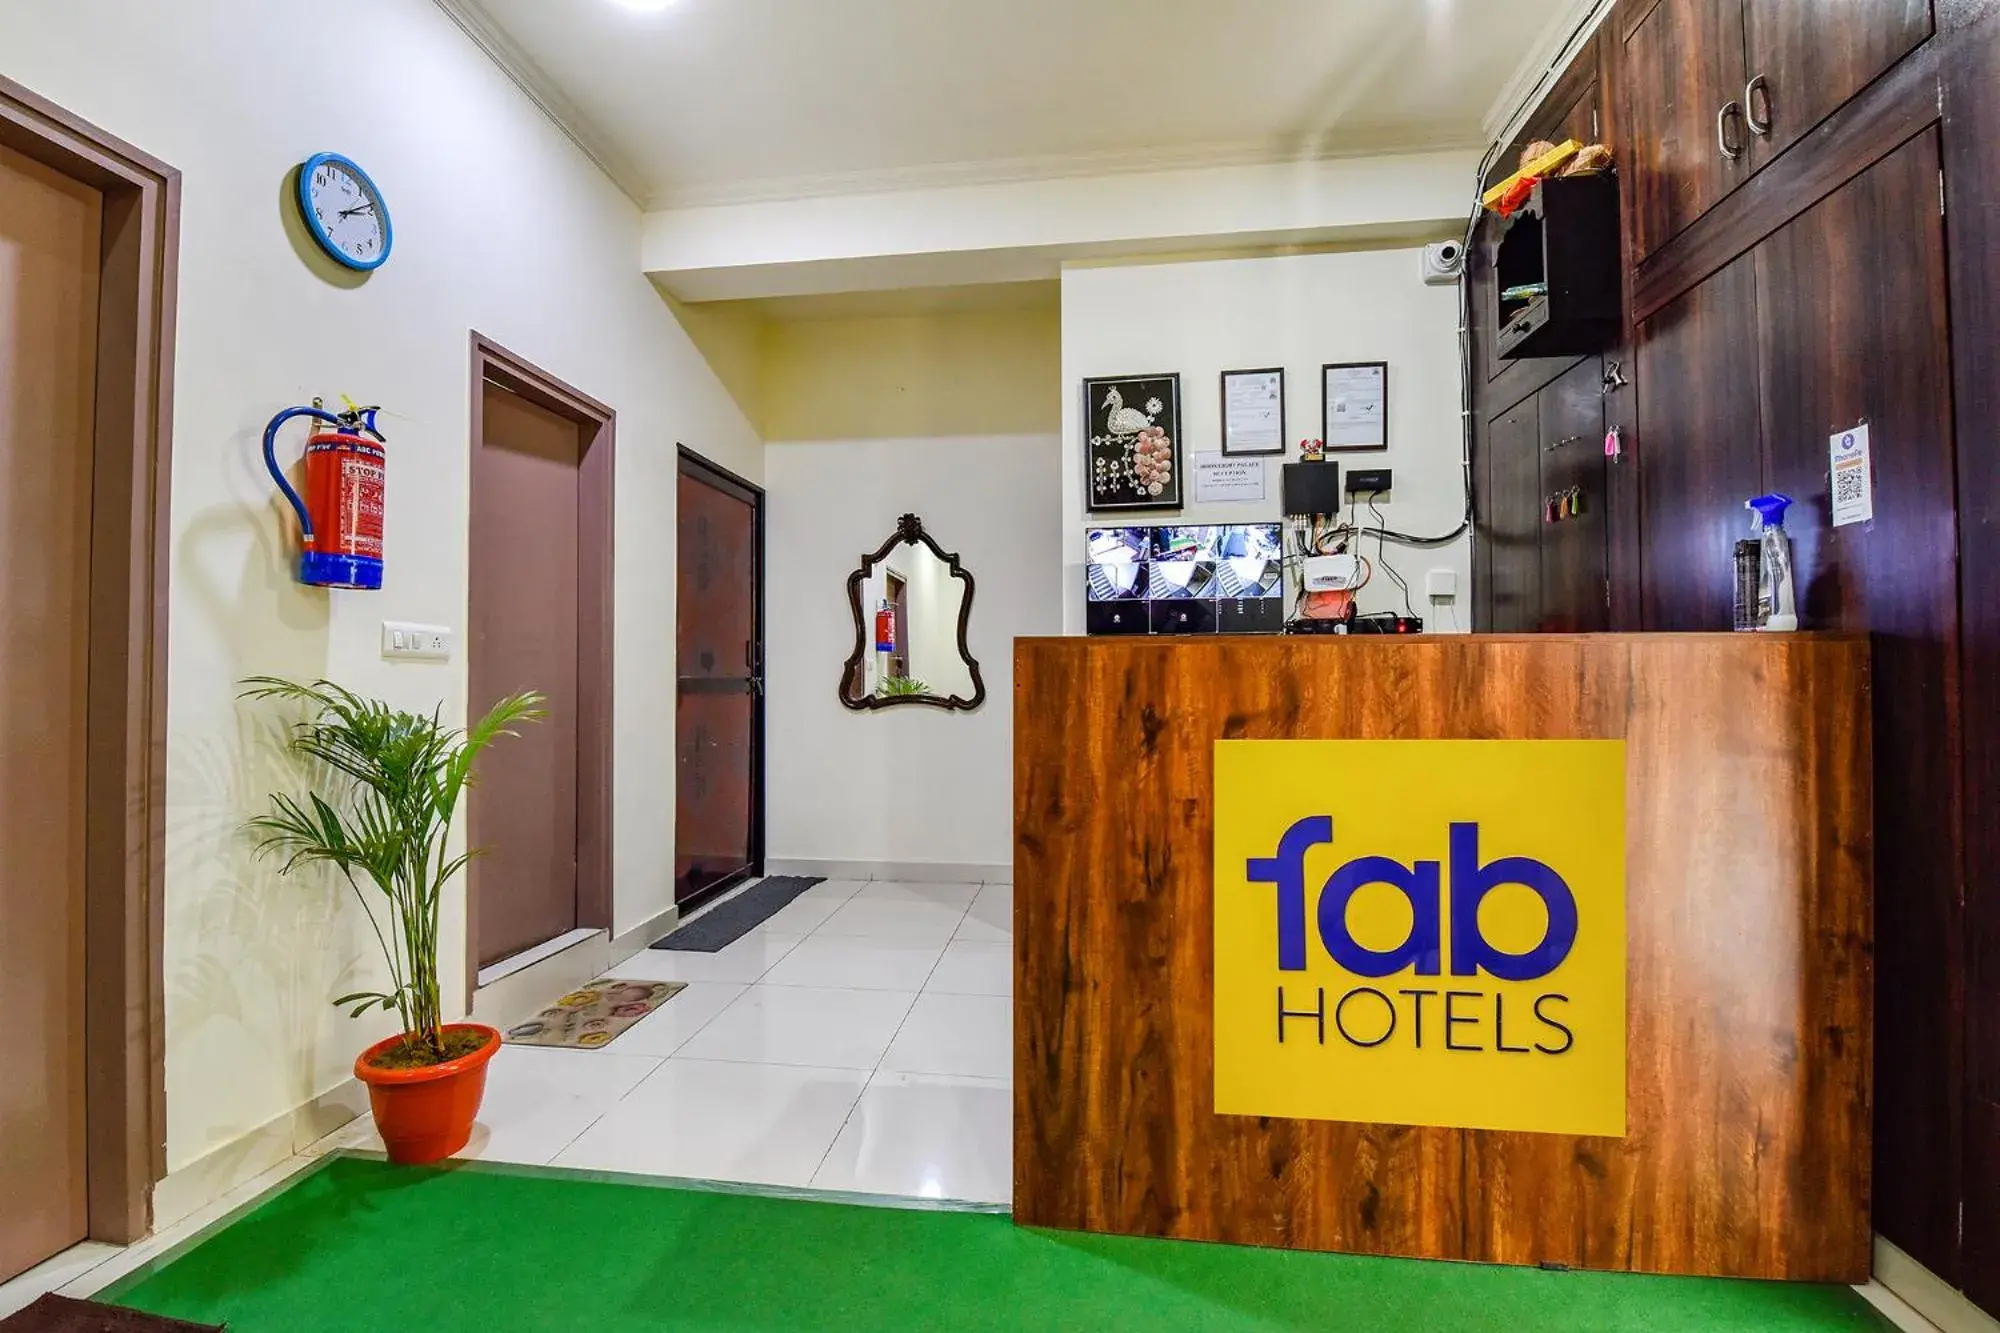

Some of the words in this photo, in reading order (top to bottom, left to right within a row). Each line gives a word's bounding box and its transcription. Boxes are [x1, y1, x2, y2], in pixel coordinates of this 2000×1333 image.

[348, 465, 377, 476] STOP
[1246, 815, 1579, 982] fab
[1278, 986, 1575, 1056] HOTELS
